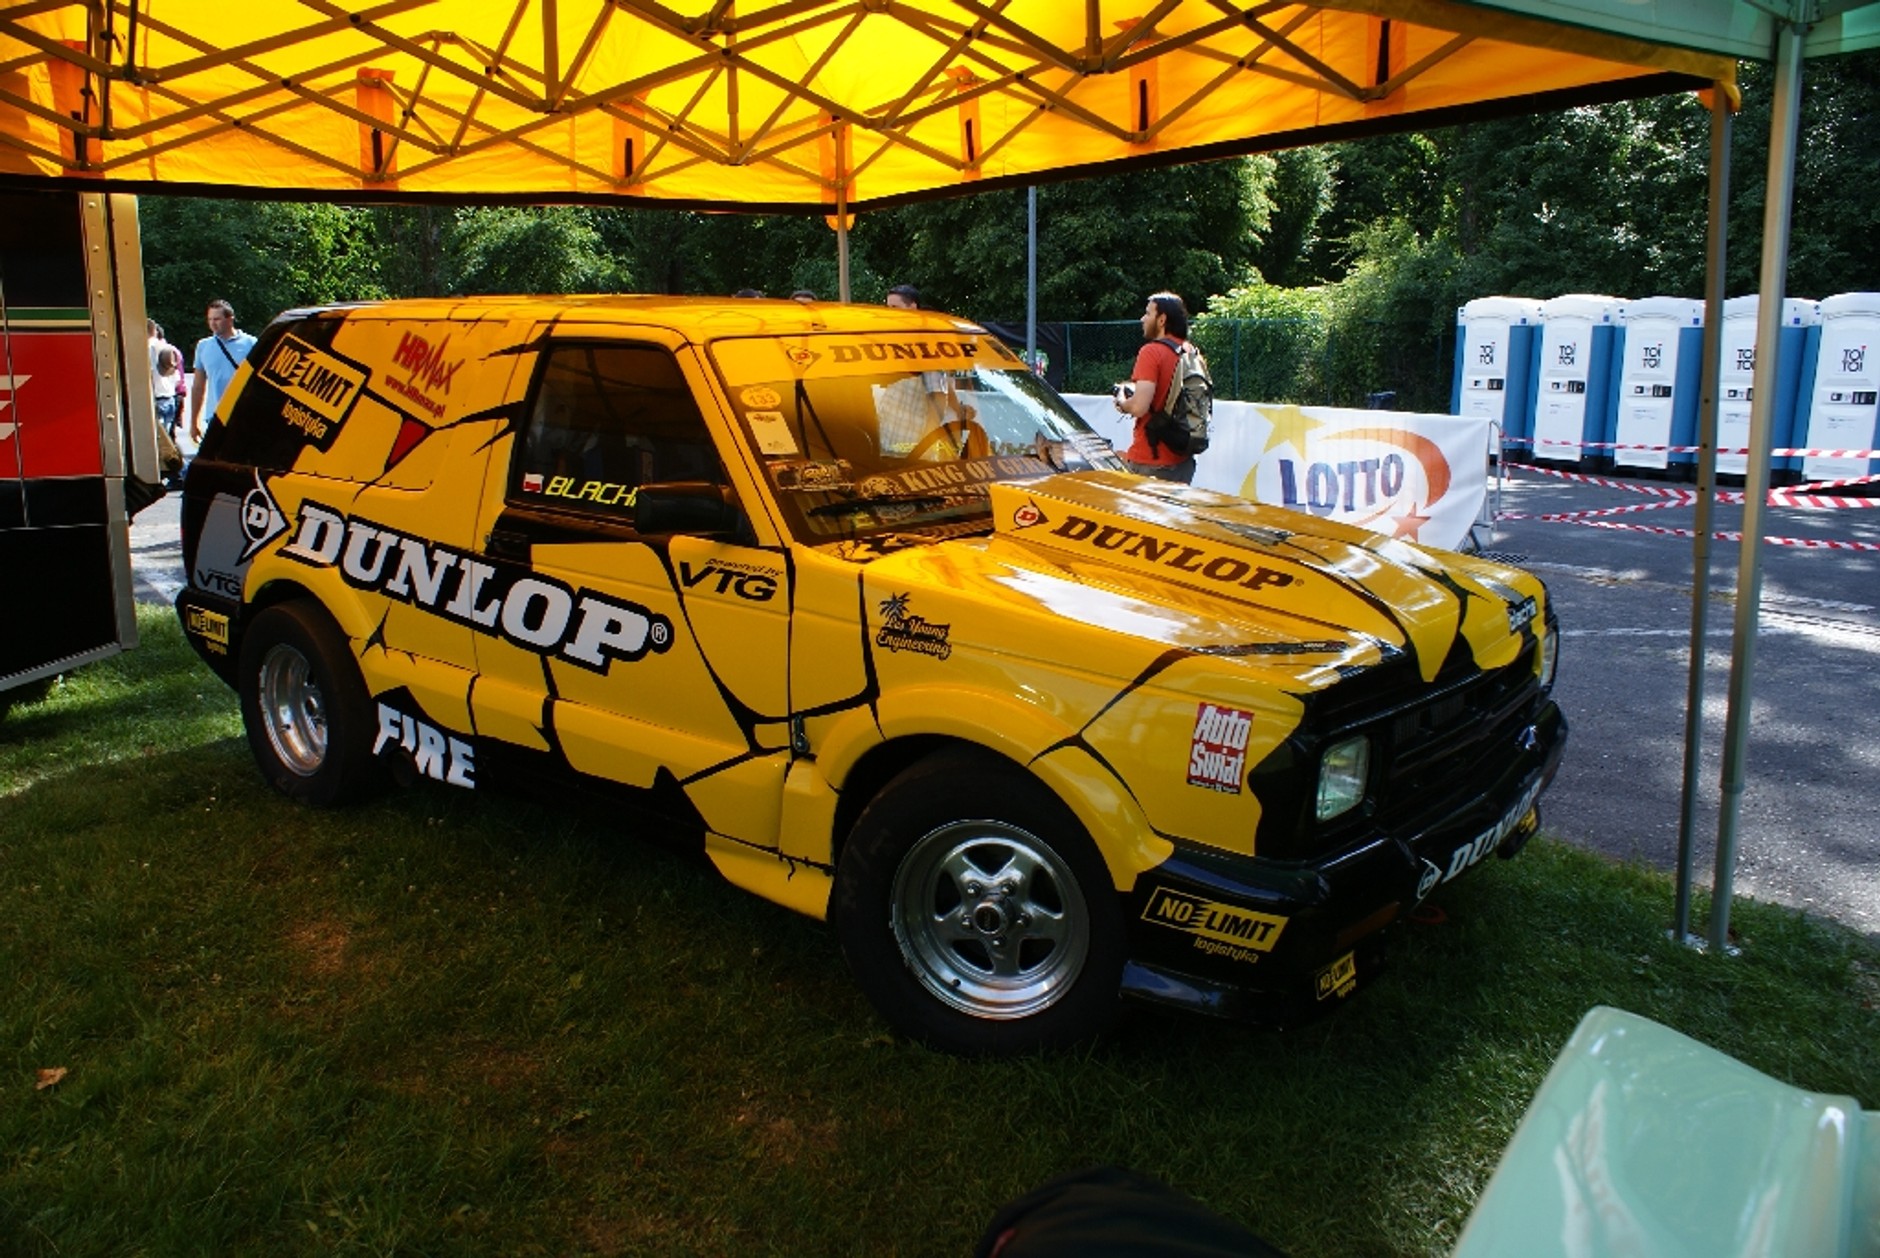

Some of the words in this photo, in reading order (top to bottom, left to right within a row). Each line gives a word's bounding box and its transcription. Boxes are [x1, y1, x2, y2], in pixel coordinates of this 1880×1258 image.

[829, 342, 977, 362] DUNLOP
[270, 345, 300, 377] NO
[297, 361, 355, 407] LIMIT
[281, 399, 328, 438] logistyka
[897, 464, 966, 493] KING
[966, 459, 997, 481] OF
[1278, 453, 1404, 517] LOTTO
[1049, 514, 1294, 592] DUNLOP
[197, 568, 241, 596] VTG
[283, 506, 649, 666] DUNLOP
[680, 561, 778, 602] VTG
[373, 701, 475, 789] FIRE
[1193, 704, 1252, 751] Auto
[1157, 897, 1193, 923] NO
[1204, 910, 1276, 943] LIMIT
[1193, 936, 1260, 964] logistyka
